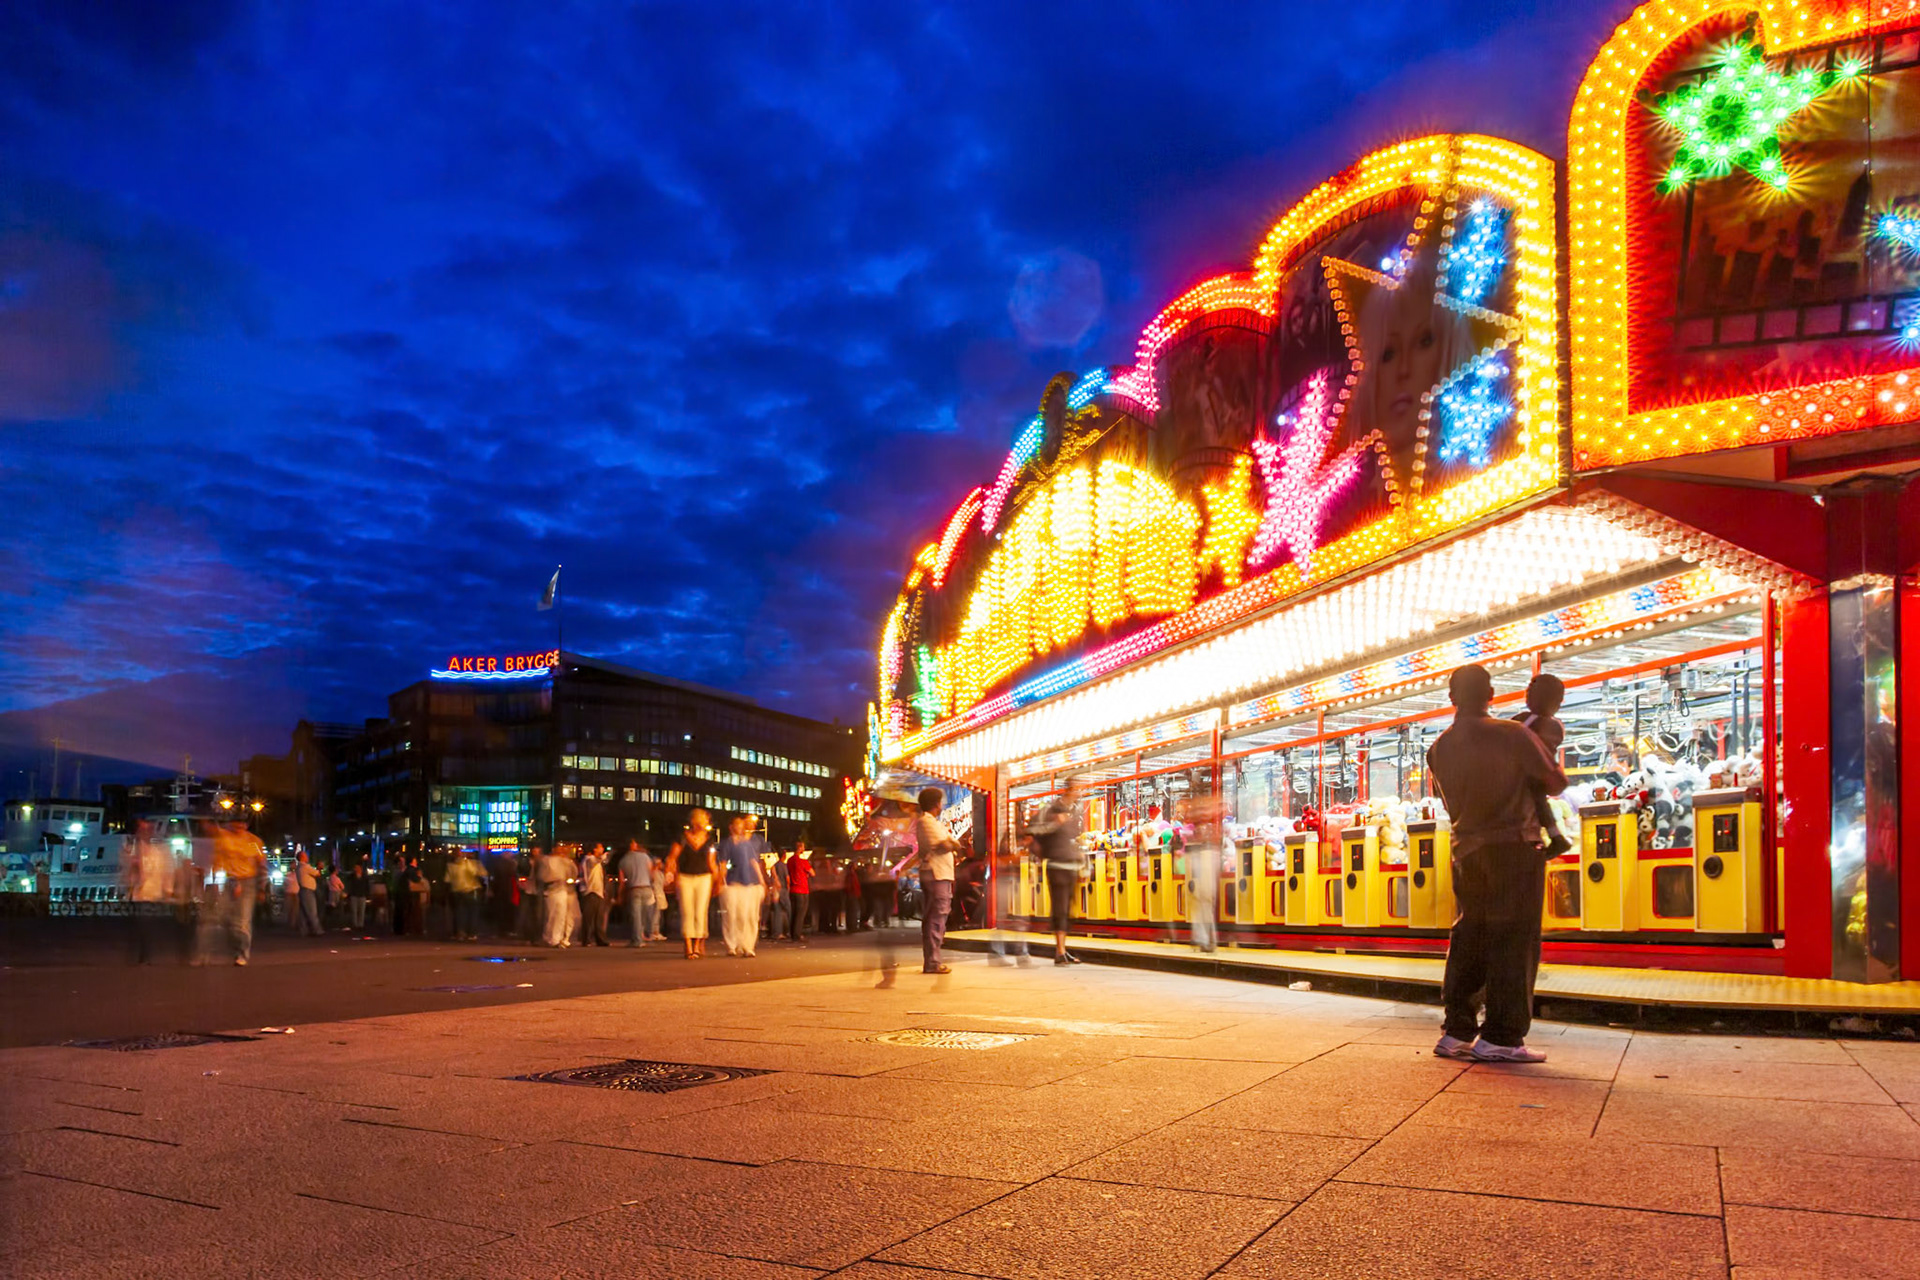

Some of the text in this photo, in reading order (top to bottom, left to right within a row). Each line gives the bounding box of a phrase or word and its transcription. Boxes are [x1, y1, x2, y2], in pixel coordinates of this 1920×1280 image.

[448, 649, 560, 672] AKER BRYGGE
[488, 837, 518, 845] SHOPPING
